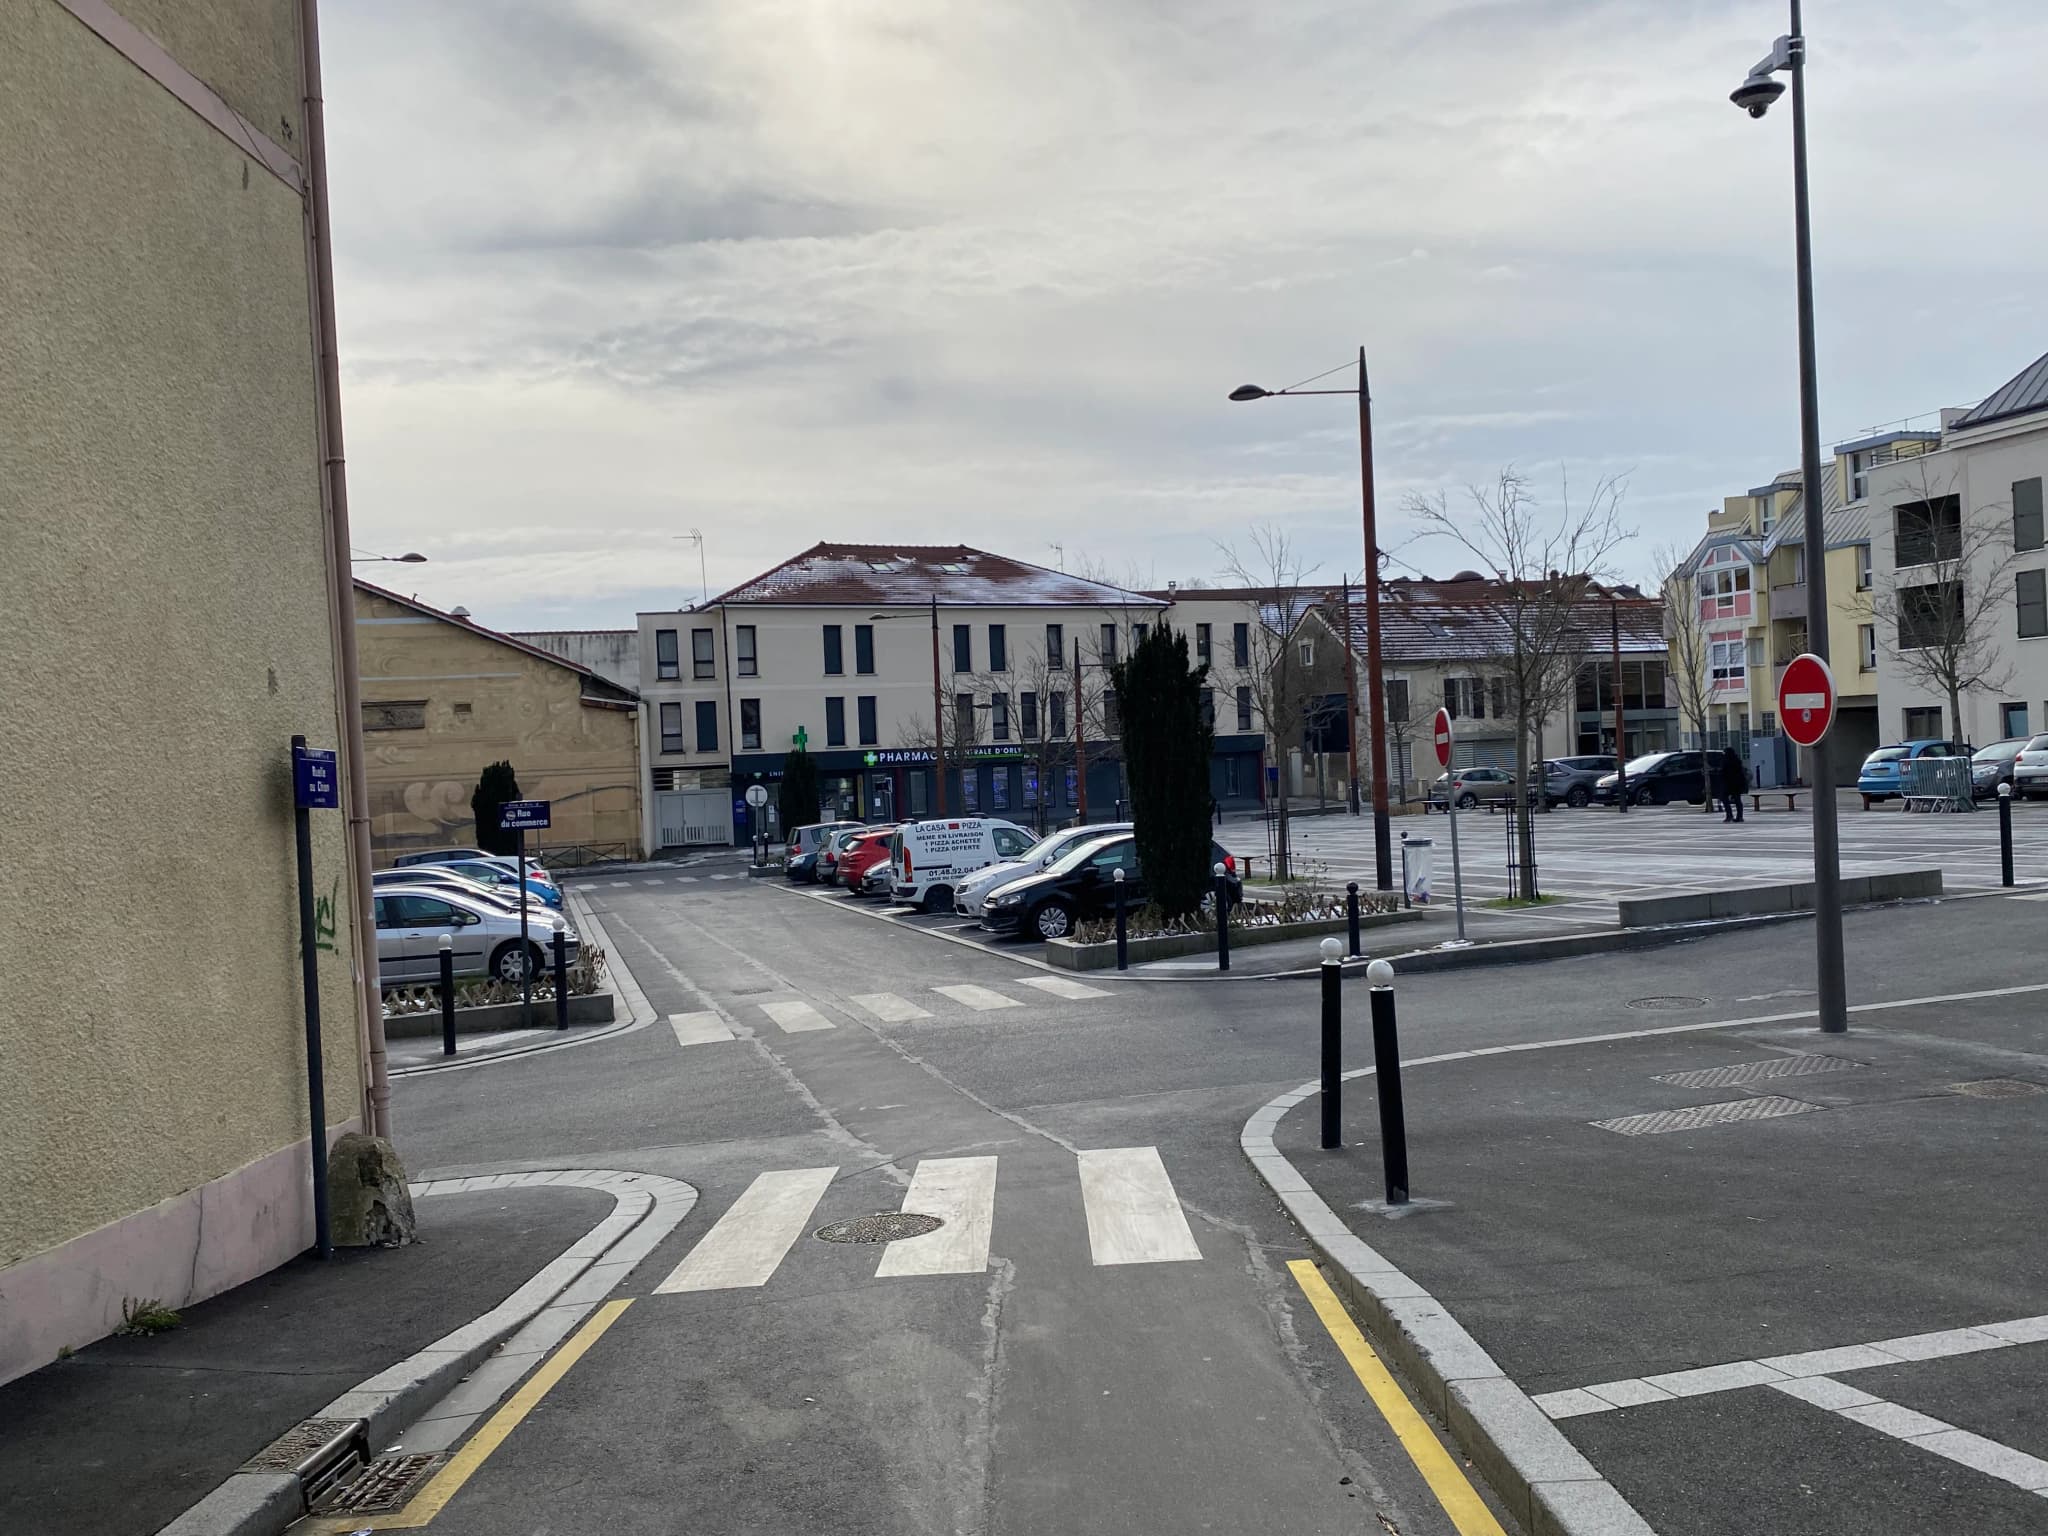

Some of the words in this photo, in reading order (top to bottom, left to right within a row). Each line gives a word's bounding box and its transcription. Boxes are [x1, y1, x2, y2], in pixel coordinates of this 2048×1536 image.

[879, 750, 950, 762] PHARMACE
[517, 809, 531, 817] Rue
[501, 819, 510, 828] du
[926, 824, 946, 832] CASA
[948, 831, 984, 839] LIVRAISON
[928, 866, 984, 877] 01.48.92.04.
